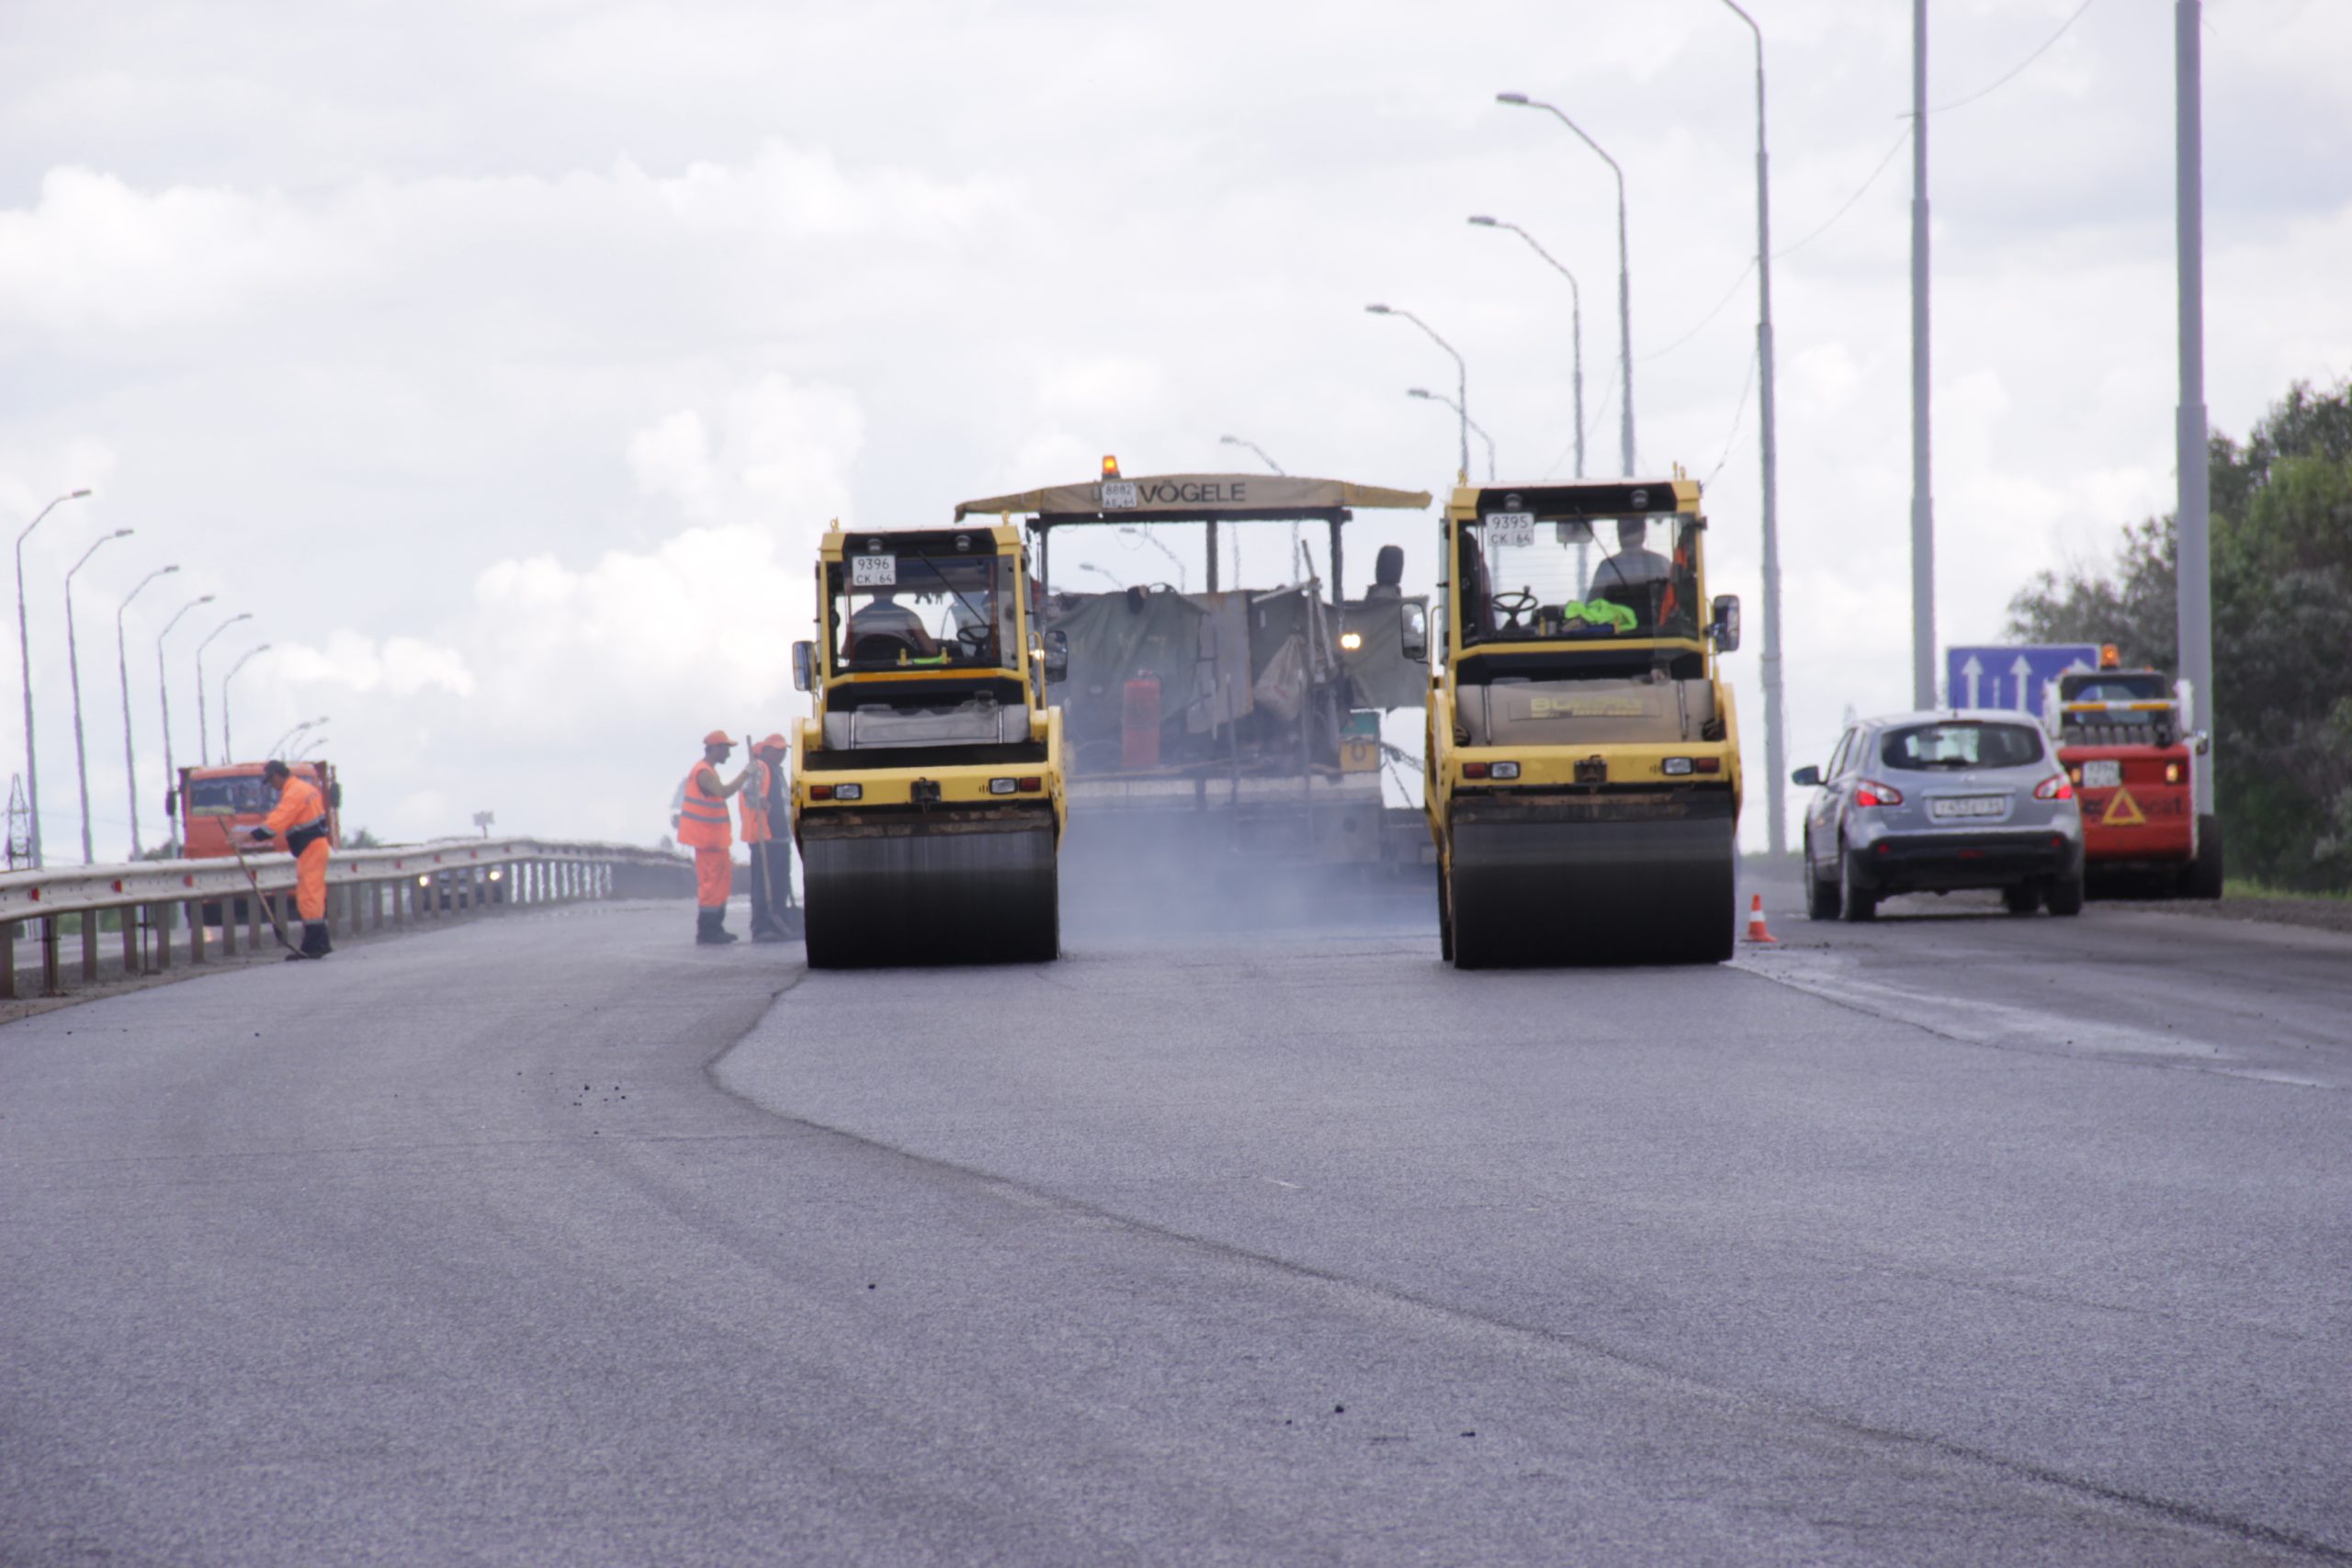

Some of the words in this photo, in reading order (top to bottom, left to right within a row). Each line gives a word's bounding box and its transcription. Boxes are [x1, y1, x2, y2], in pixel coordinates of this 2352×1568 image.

[1139, 480, 1246, 503] VÖGELE
[1491, 516, 1528, 529] 9395
[1516, 534, 1531, 544] 64
[857, 558, 890, 570] 9396
[879, 574, 892, 584] 64
